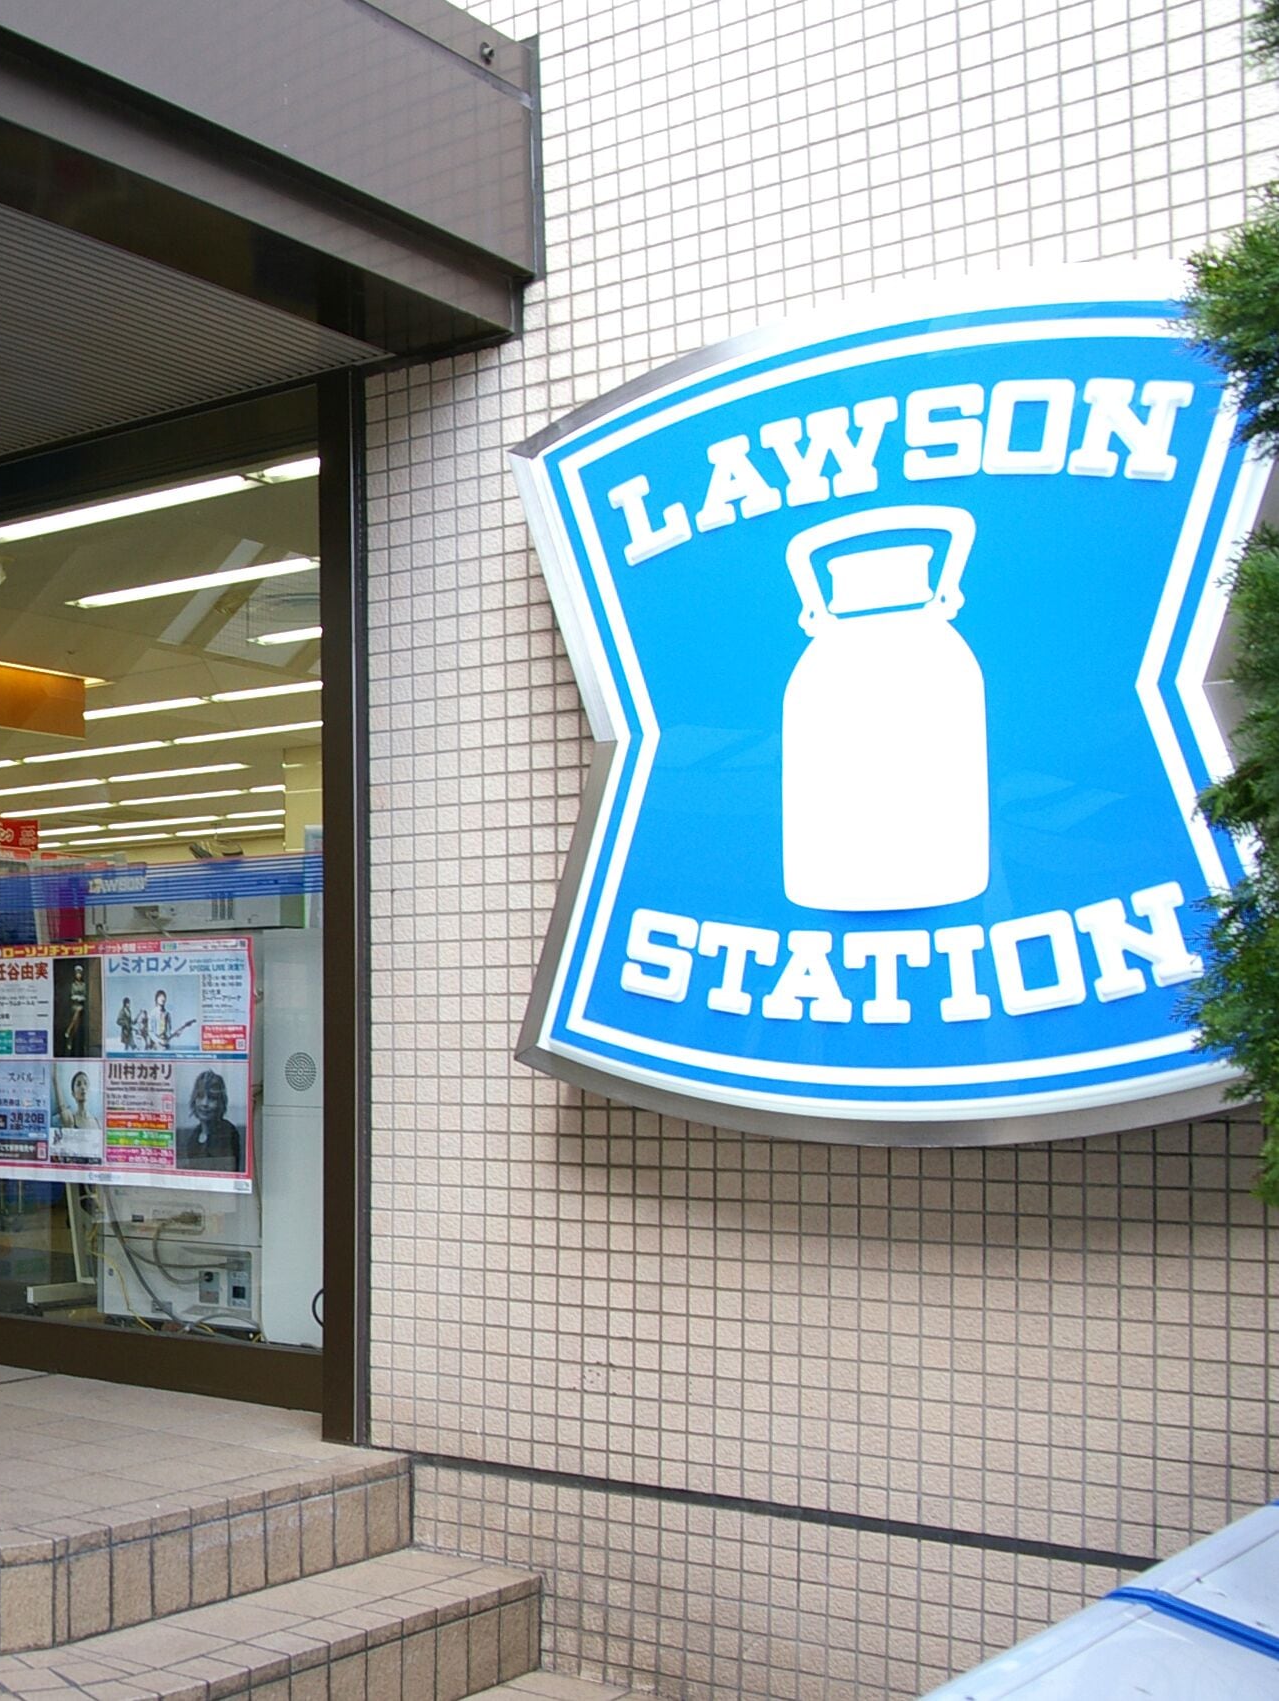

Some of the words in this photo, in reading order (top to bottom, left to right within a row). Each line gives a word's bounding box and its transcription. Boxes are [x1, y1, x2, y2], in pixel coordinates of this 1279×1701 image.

[607, 377, 1196, 567] LAWSON
[88, 875, 147, 894] LAWSON
[2, 943, 96, 958] ローソンチケット
[619, 880, 1206, 1024] STATION
[107, 955, 188, 974] レミオロメン
[108, 1062, 172, 1081] 川村カオリ
